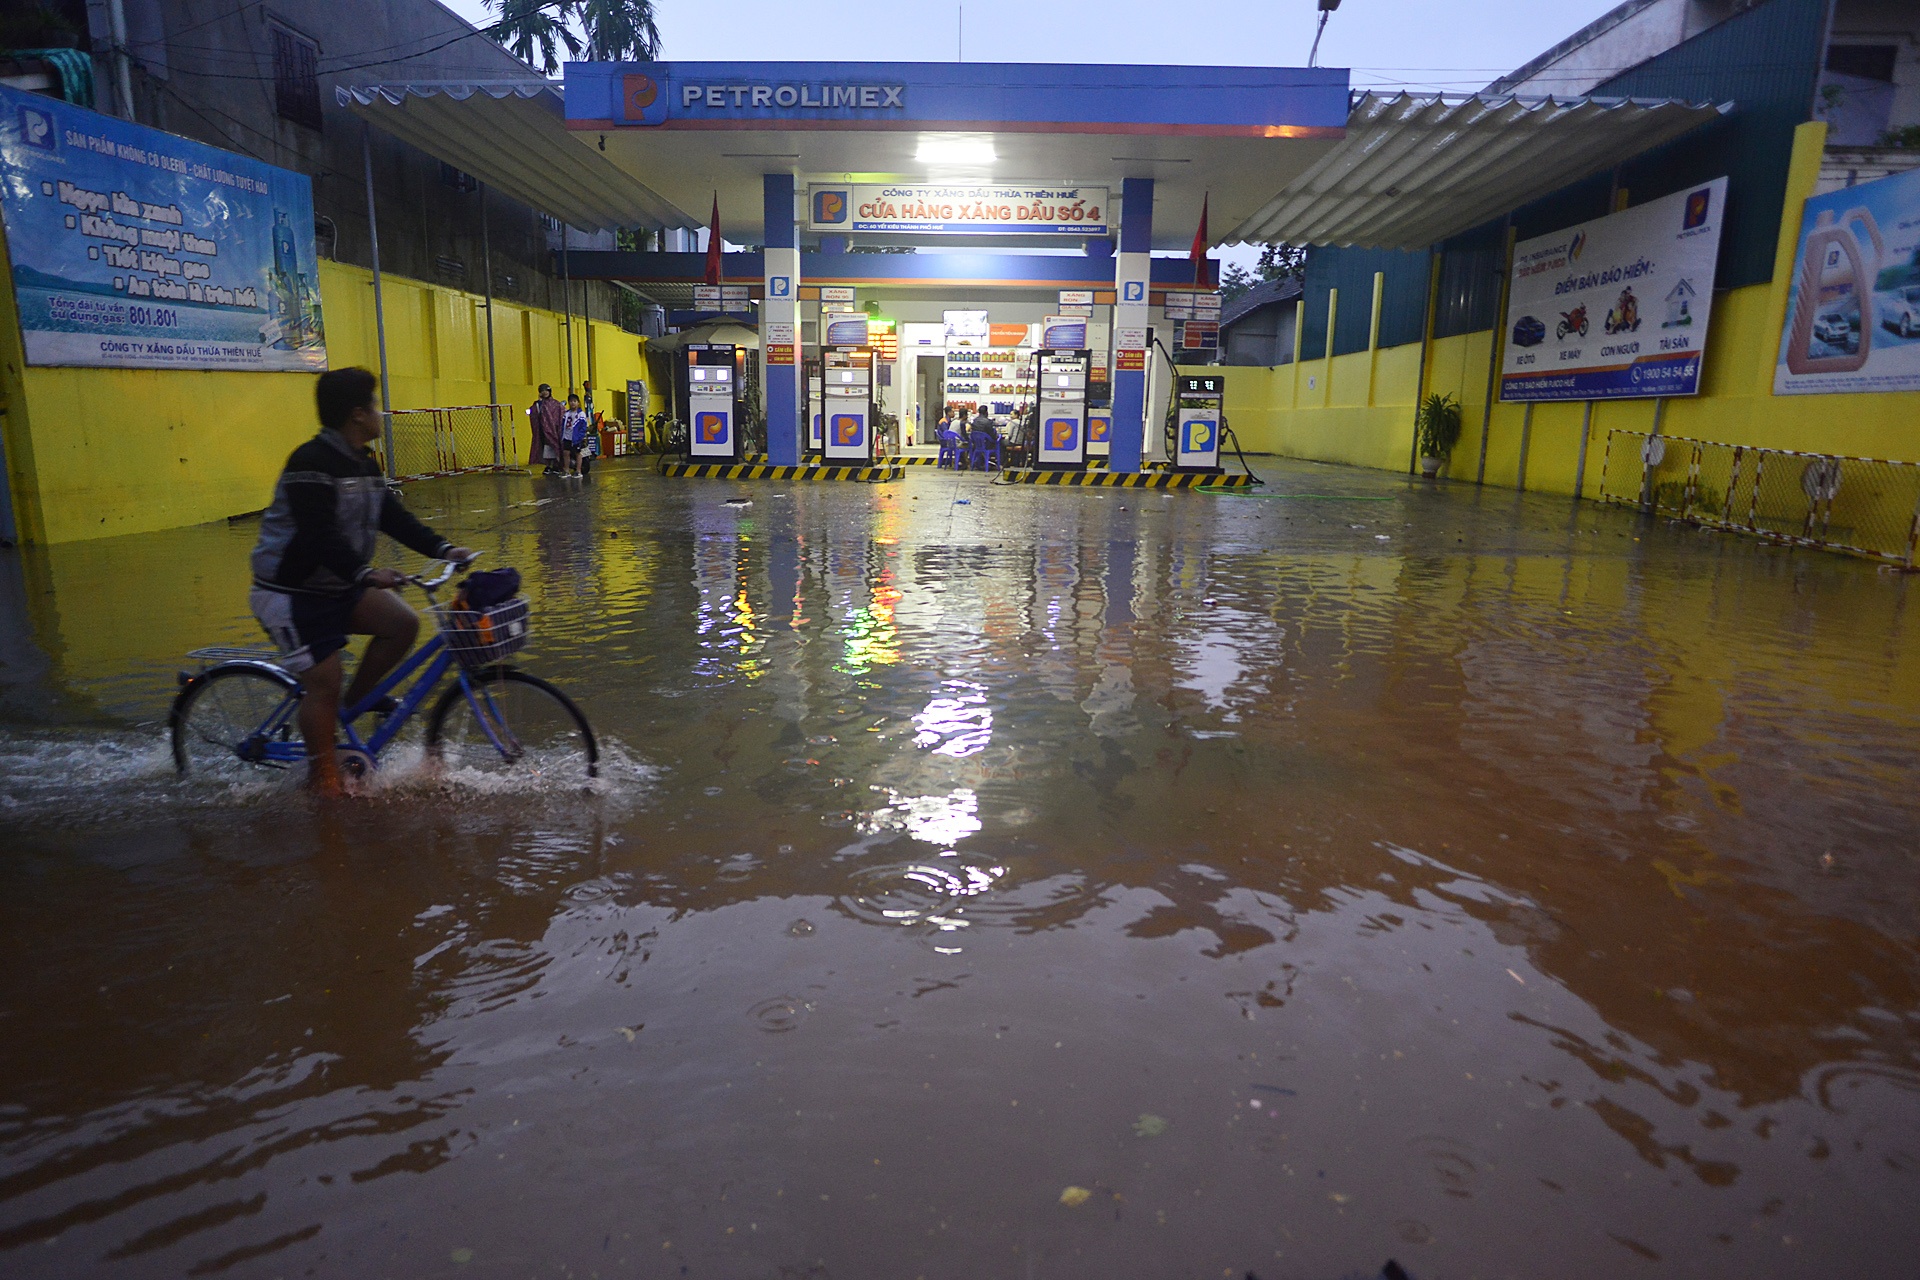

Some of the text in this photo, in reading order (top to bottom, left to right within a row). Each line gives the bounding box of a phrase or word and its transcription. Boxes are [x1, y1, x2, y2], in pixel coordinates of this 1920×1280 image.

[682, 85, 904, 107] PETROLIMEX
[882, 188, 914, 197] CÔNG
[916, 189, 931, 197] TY
[934, 189, 964, 198] XĂNG
[993, 189, 1022, 198] THỪA
[1024, 190, 1054, 198] THIÊN
[1057, 189, 1079, 199] HUẾ
[140, 202, 183, 226] xanh
[859, 197, 1101, 221] CỬA HÀNG XĂNG DẦU SỐ 4
[79, 213, 139, 247] Không
[128, 275, 151, 297] An
[48, 296, 75, 309] Tổng
[95, 302, 106, 311] tư
[107, 302, 125, 313] vấn
[69, 310, 99, 323] dụng
[102, 314, 125, 323] gas:
[129, 306, 178, 327] 801.801
[100, 340, 129, 352] CÔNG
[131, 343, 143, 352] TY
[146, 342, 174, 354] XĂNG
[197, 345, 220, 356] THỪA
[222, 346, 244, 357] THIÊN
[246, 346, 262, 358] HUẾ
[1643, 365, 1694, 379] 1900 54 54 55
